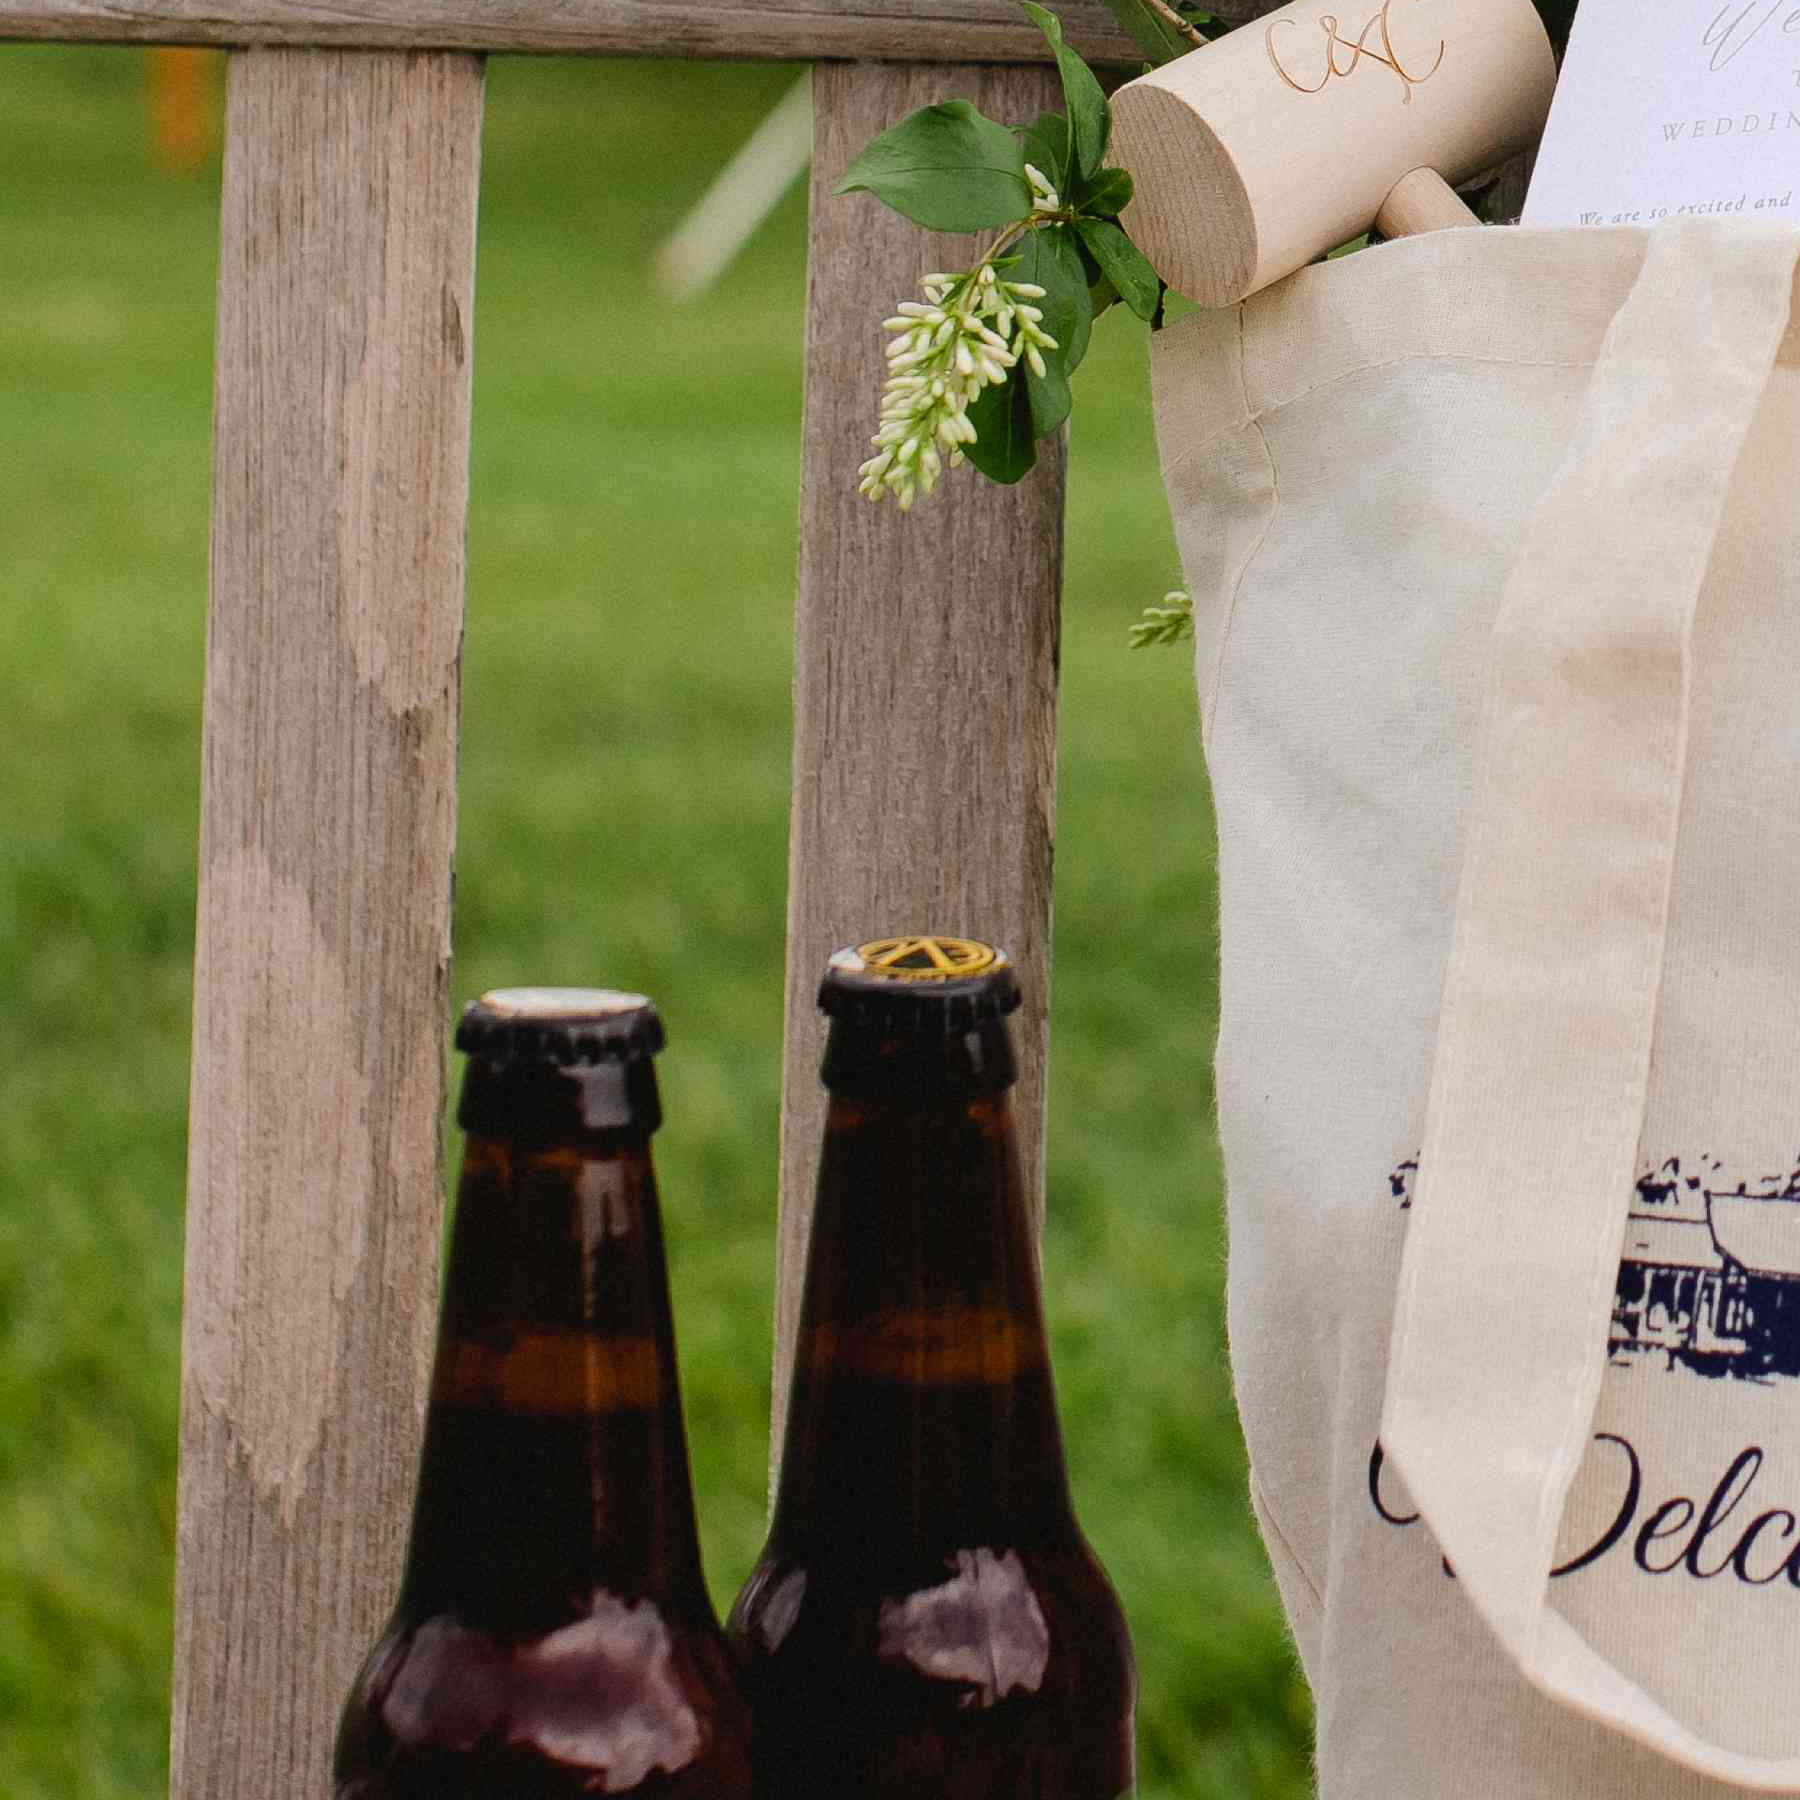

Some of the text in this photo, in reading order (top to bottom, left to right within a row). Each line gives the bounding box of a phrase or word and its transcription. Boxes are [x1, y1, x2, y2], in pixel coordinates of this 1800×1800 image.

[1579, 211, 1603, 226] We
[1612, 210, 1640, 224] are
[1648, 206, 1668, 220] so
[1678, 195, 1746, 215] excited
[1755, 192, 1793, 210] and
